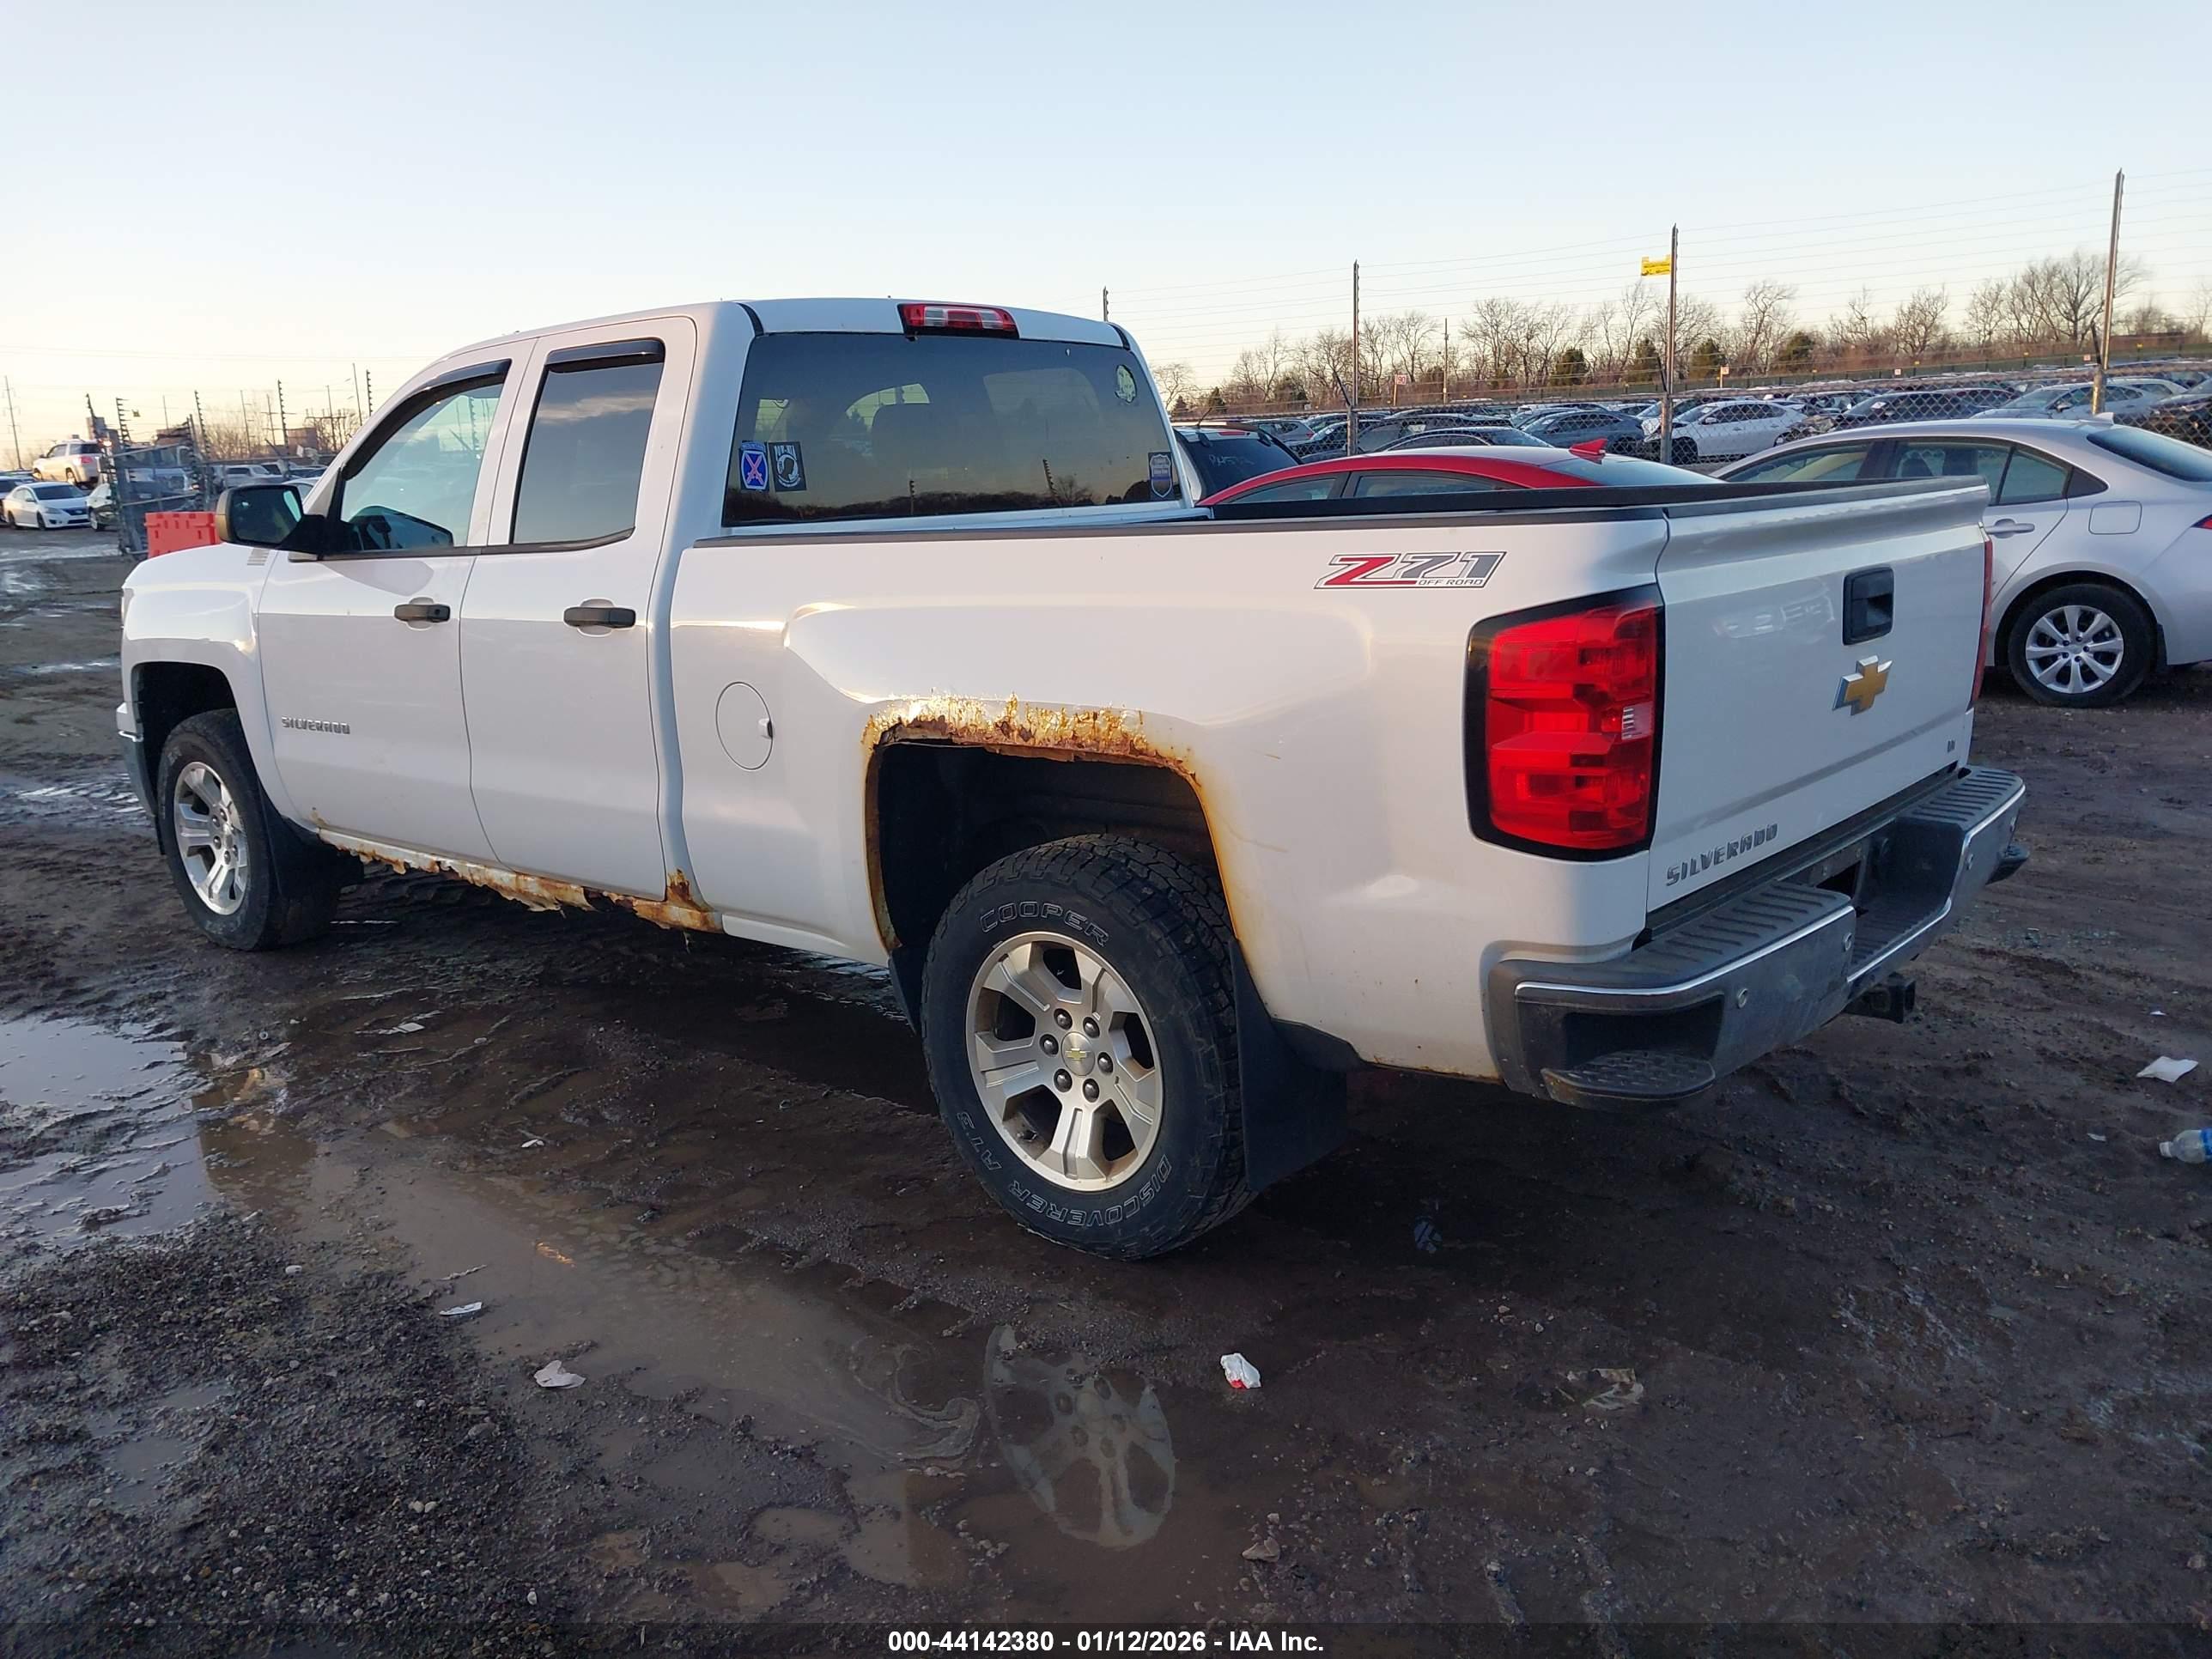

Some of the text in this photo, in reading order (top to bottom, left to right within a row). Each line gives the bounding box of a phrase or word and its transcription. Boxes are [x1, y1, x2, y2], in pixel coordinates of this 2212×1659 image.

[1314, 551, 1506, 589] Z71
[281, 716, 350, 735] SILVERADO
[1666, 823, 1778, 886] SILVERADO
[980, 902, 1109, 947] COOPER
[1008, 1154, 1172, 1227] DISCOVERER
